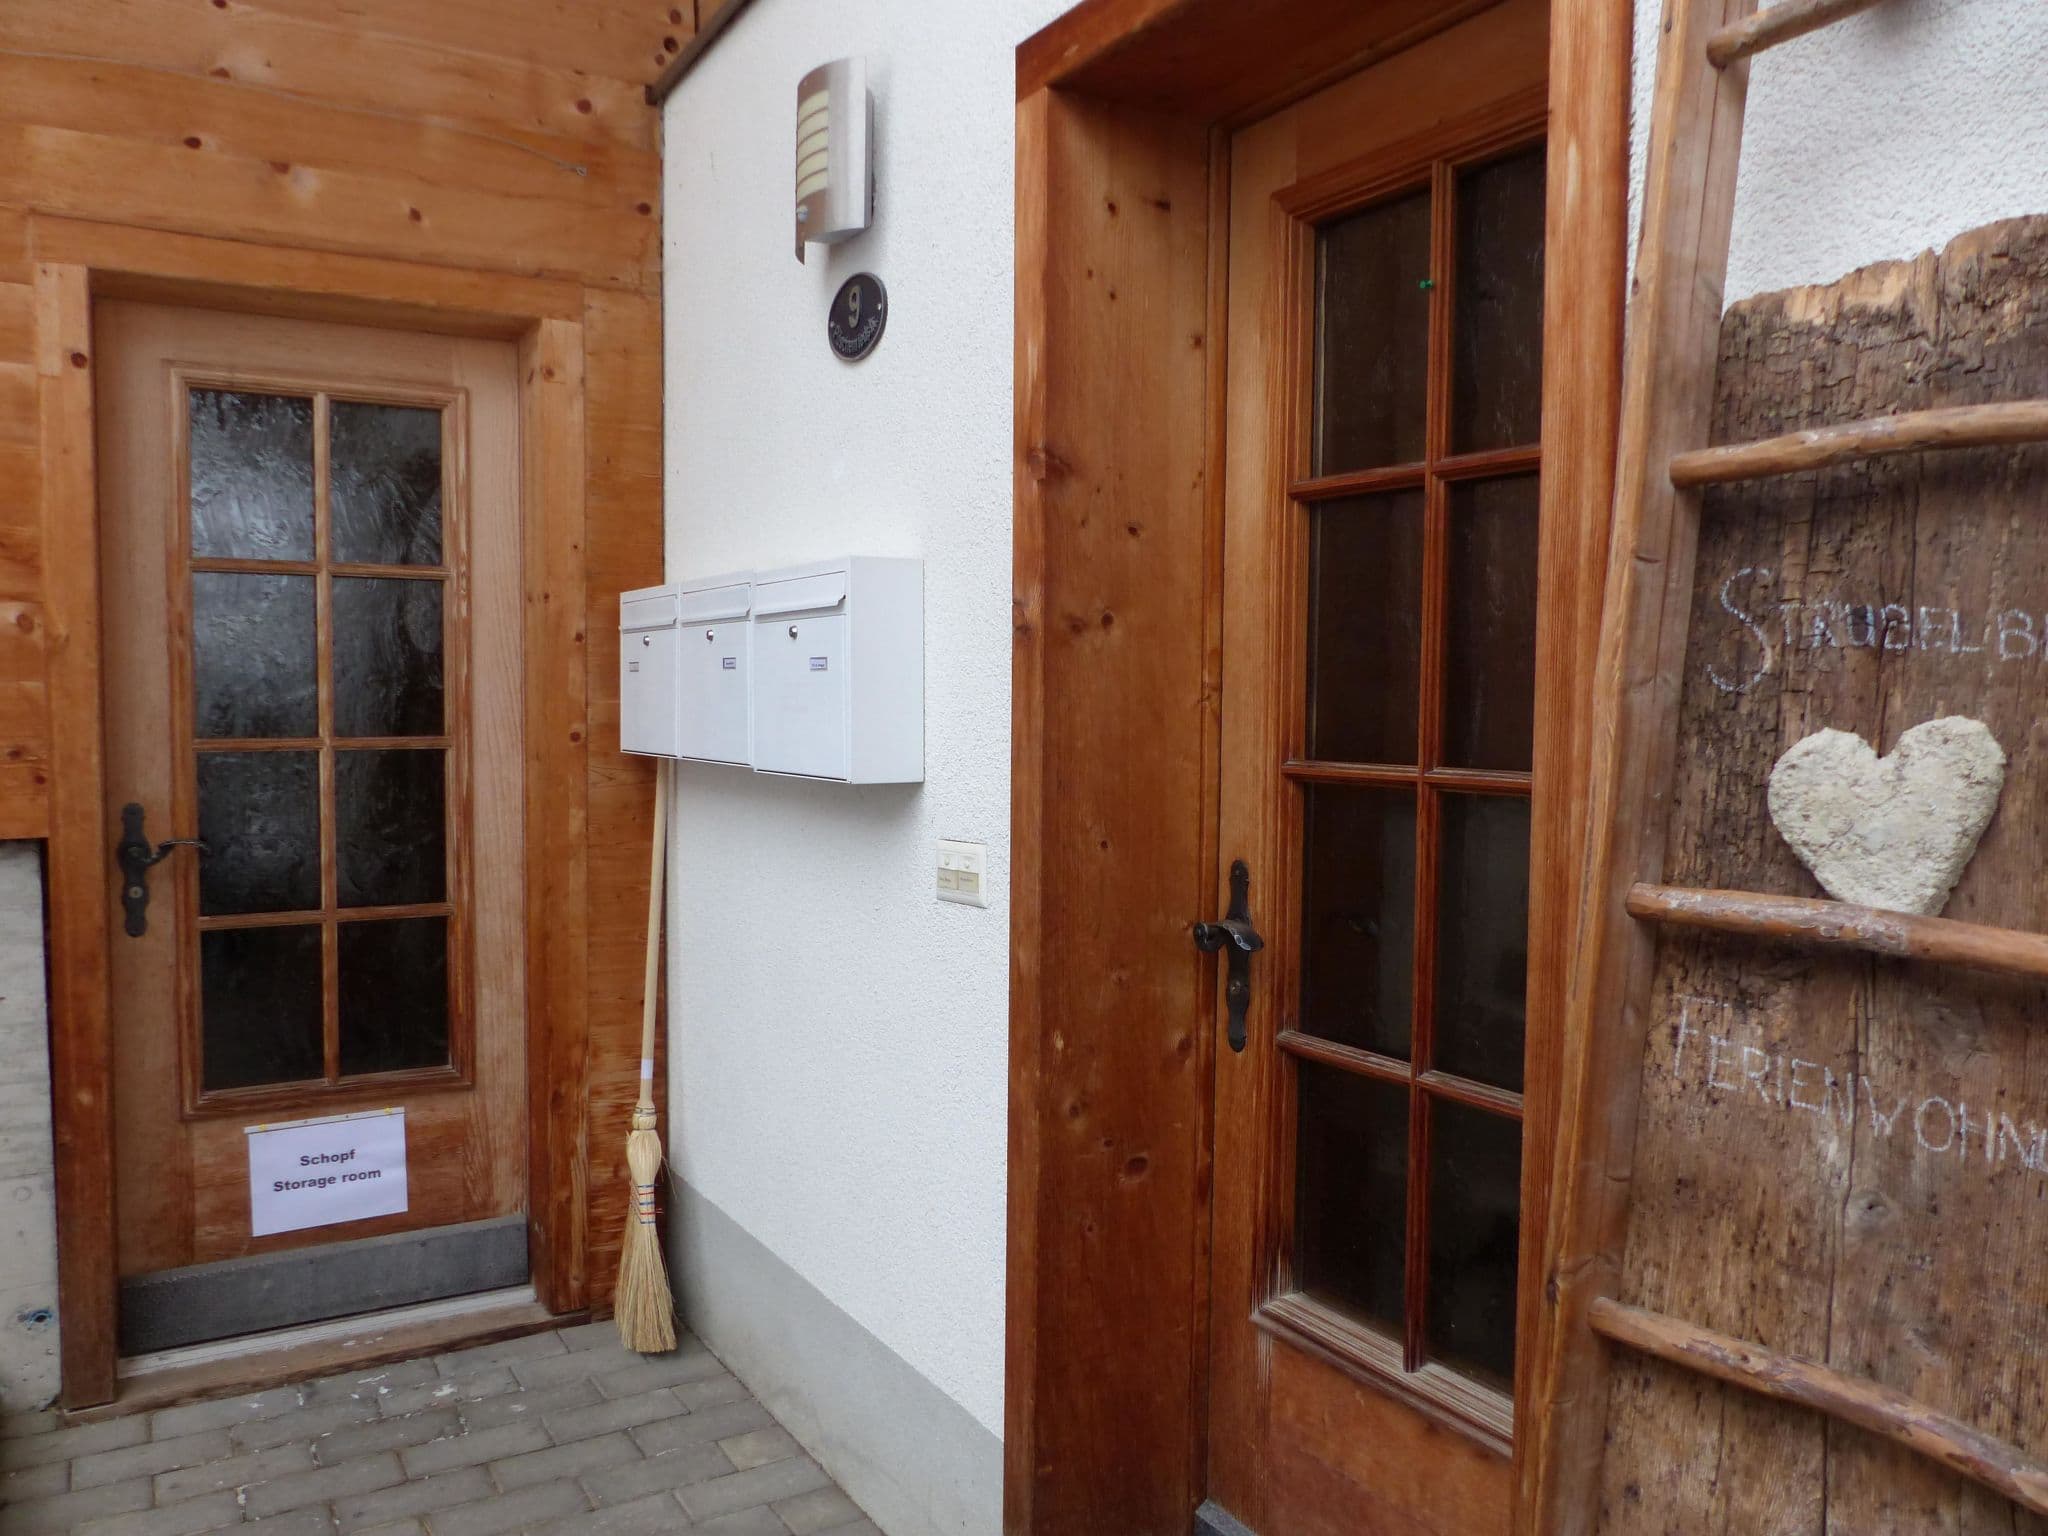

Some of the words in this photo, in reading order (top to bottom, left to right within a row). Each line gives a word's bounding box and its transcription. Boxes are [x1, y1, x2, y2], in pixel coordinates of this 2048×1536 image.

[848, 284, 861, 329] 9
[300, 1149, 356, 1166] Schopf
[273, 1173, 337, 1192] Storage
[342, 1169, 381, 1183] room
